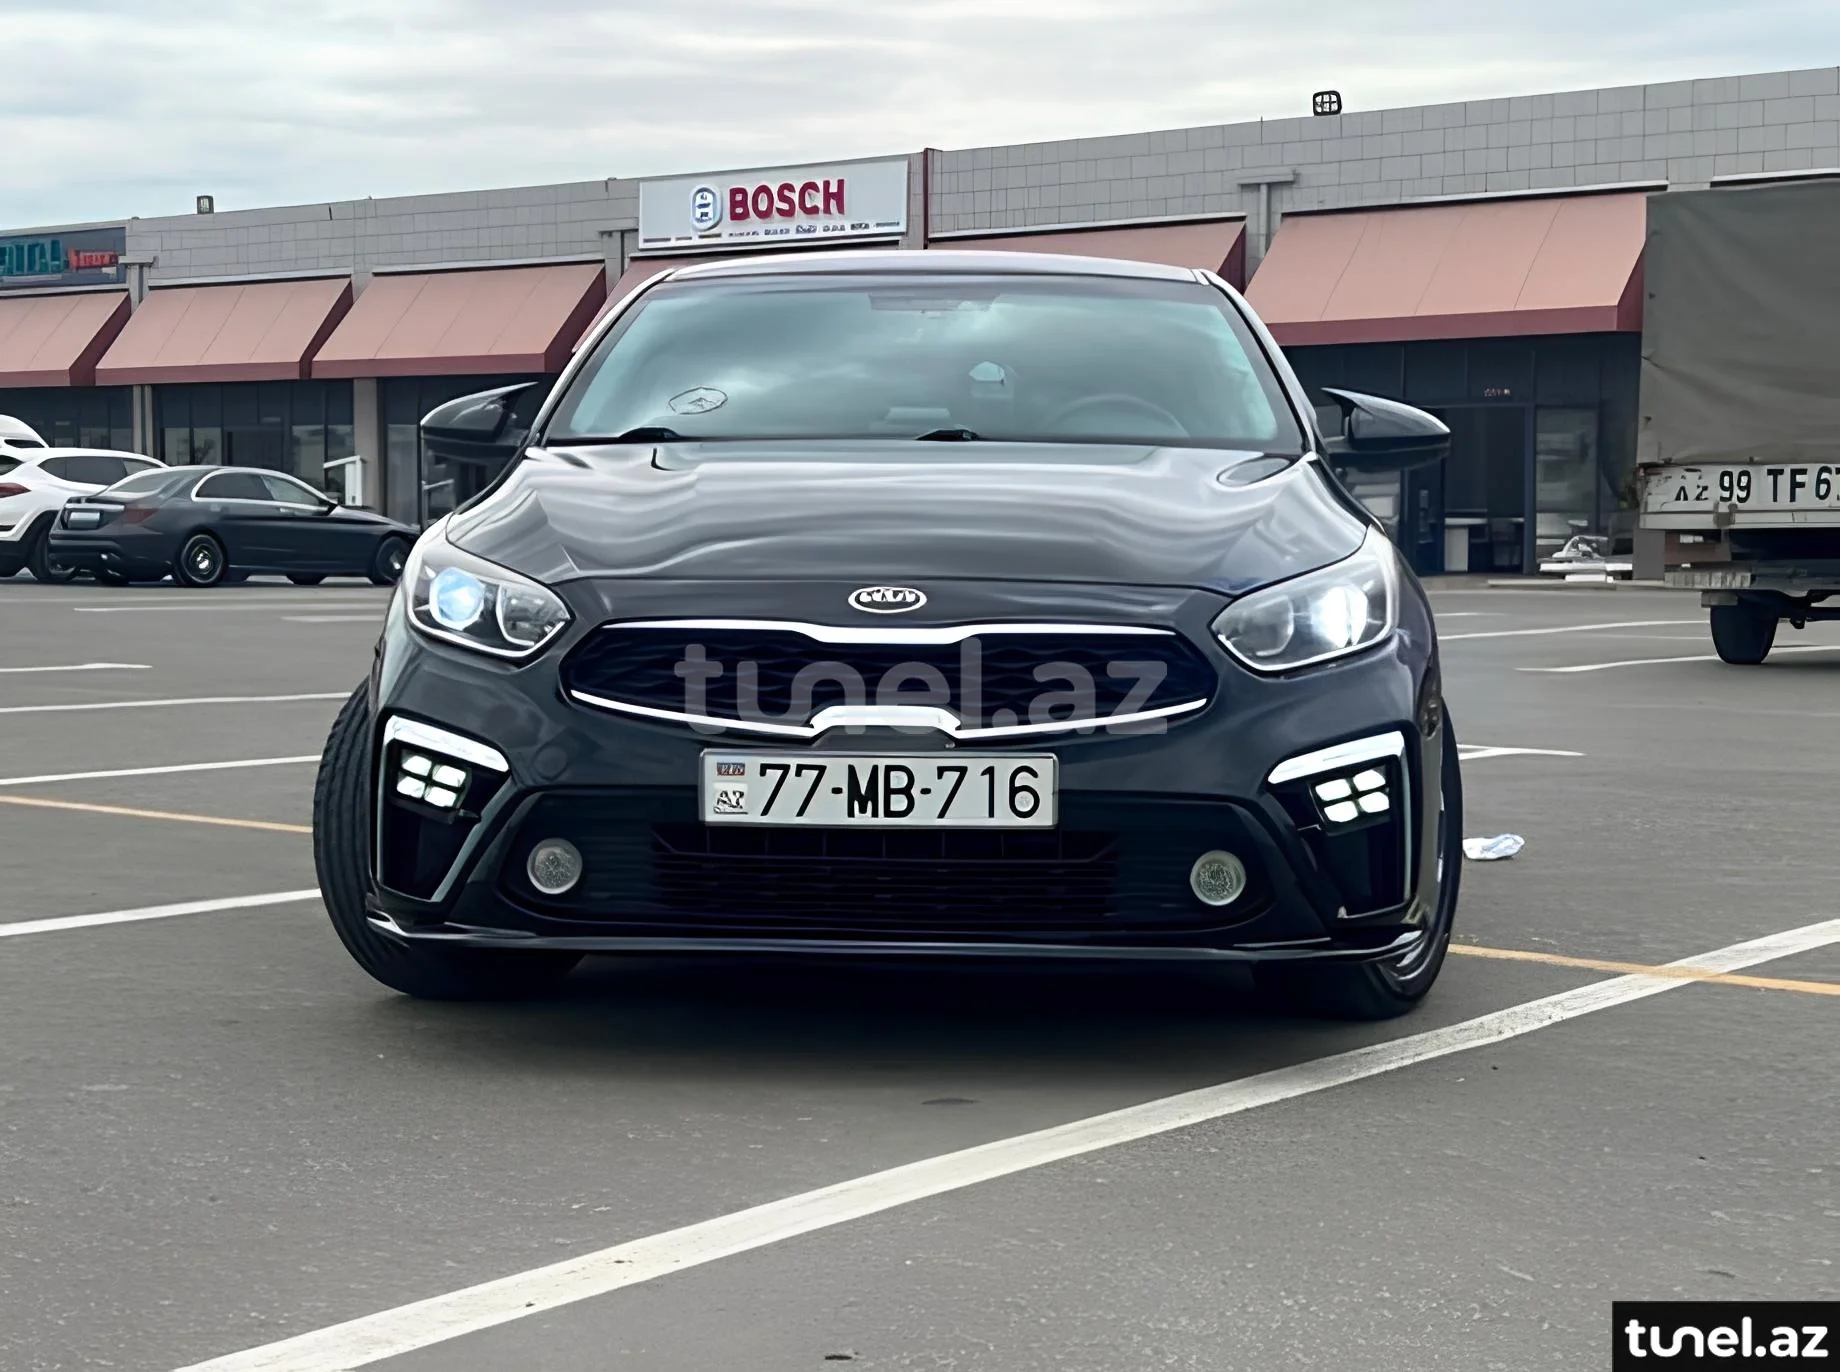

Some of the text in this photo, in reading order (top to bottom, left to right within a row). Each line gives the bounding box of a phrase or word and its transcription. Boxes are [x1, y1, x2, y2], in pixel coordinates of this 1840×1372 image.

[729, 178, 845, 221] BOSCH
[1719, 470, 1751, 503] 99
[1767, 468, 1808, 503] TF
[759, 763, 1041, 819] 77-MB-716
